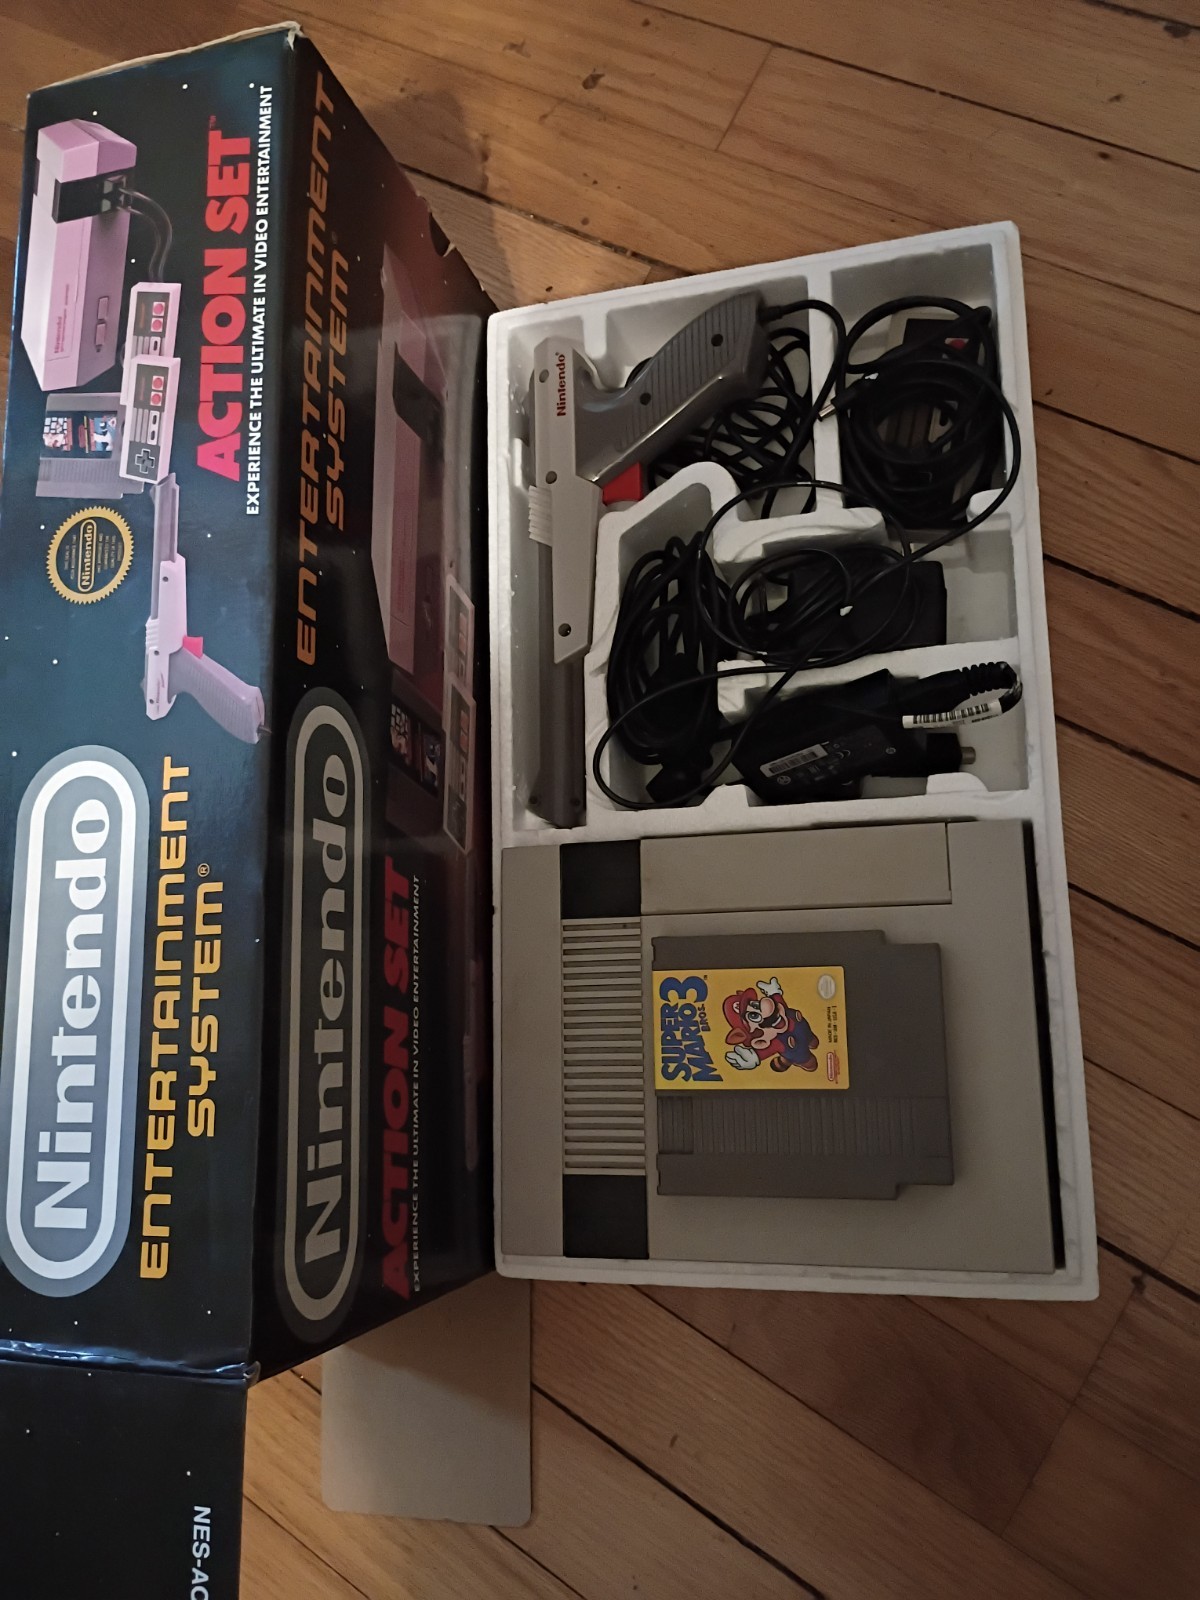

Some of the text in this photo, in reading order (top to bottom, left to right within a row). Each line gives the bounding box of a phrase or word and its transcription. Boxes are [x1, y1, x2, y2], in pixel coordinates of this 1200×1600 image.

[197, 248, 248, 482] ACTION
[246, 86, 272, 514] EXPERIENCE THE ULTIMATE IN VIDEO ENTERTAINMENT
[297, 70, 334, 666] ENTERTAINMENT
[81, 525, 93, 586] Nintendo
[34, 798, 110, 1230] Nintendo
[139, 756, 189, 1280] ENTERTAINMENT
[305, 754, 347, 1269] Nintendo
[382, 855, 410, 1299] ACTION SET
[412, 875, 421, 1292] EXPERIENCE THE ULTIMATE IN VIDEO ENTERTAINMENT
[659, 975, 709, 1003] 3
[660, 1002, 692, 1082] SUPER
[677, 1002, 724, 1082] MARIO
